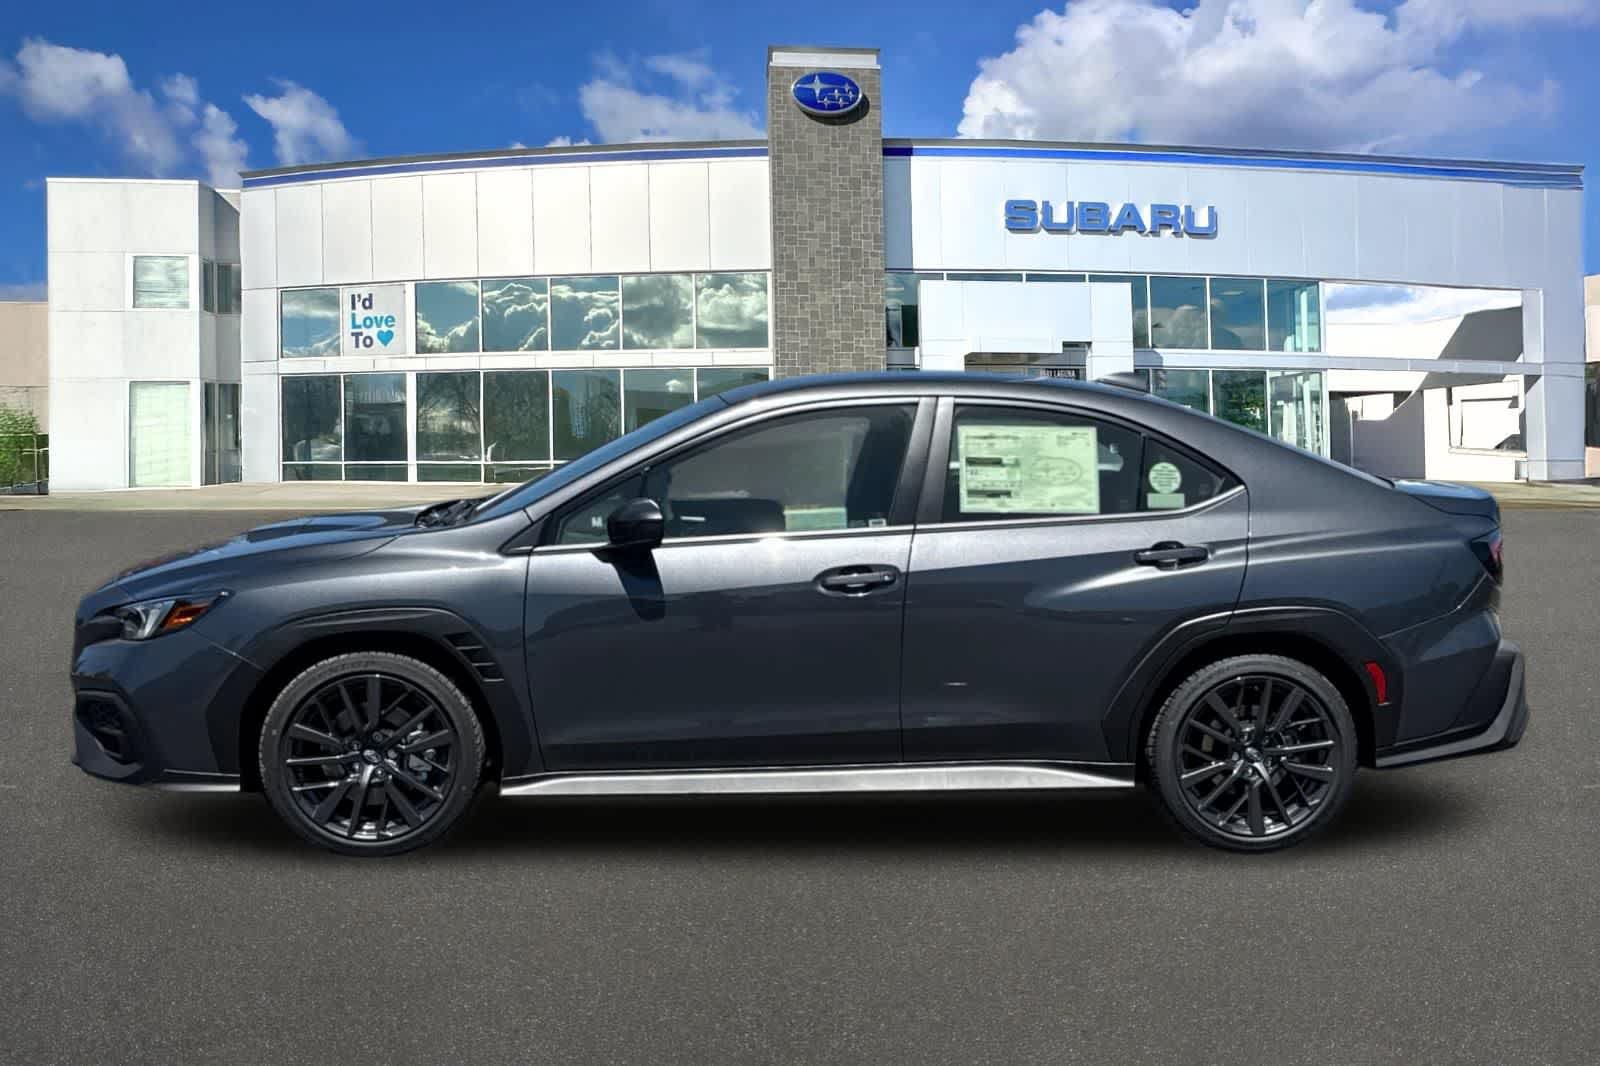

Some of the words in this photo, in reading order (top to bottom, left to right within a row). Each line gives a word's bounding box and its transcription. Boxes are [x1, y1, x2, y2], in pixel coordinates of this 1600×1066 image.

[1005, 199, 1217, 237] SUBARU
[351, 293, 373, 310] I'd
[351, 312, 396, 329] Love
[351, 331, 374, 349] To
